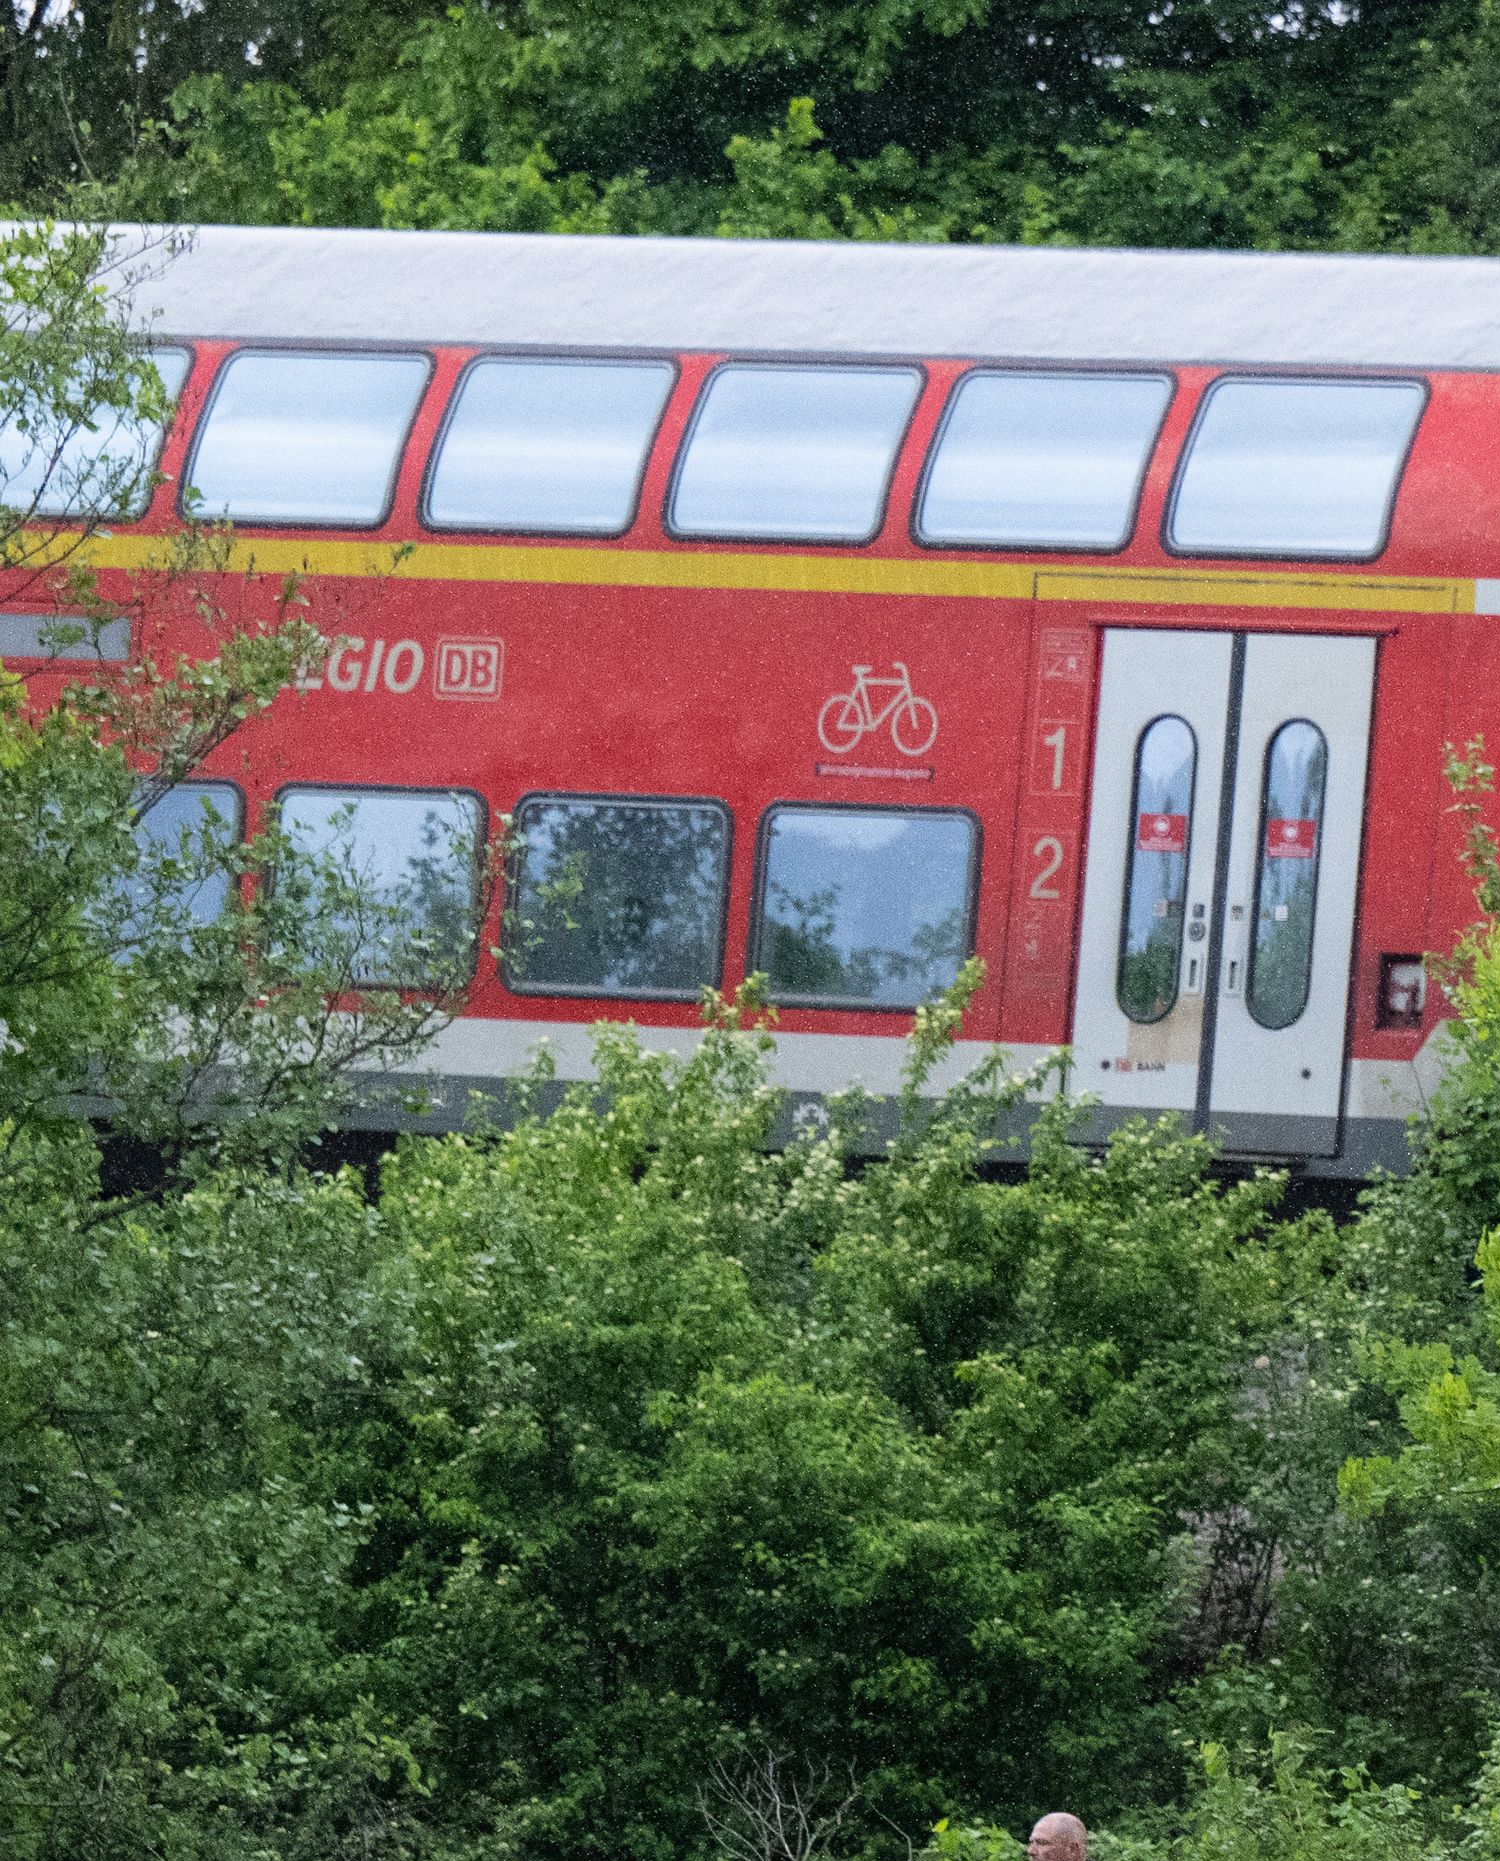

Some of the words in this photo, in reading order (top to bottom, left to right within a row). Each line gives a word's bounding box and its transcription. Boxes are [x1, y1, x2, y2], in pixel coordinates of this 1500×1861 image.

[293, 637, 425, 694] EGIO
[441, 645, 499, 693] DB
[1044, 726, 1066, 790] 1
[1028, 836, 1064, 899] 2
